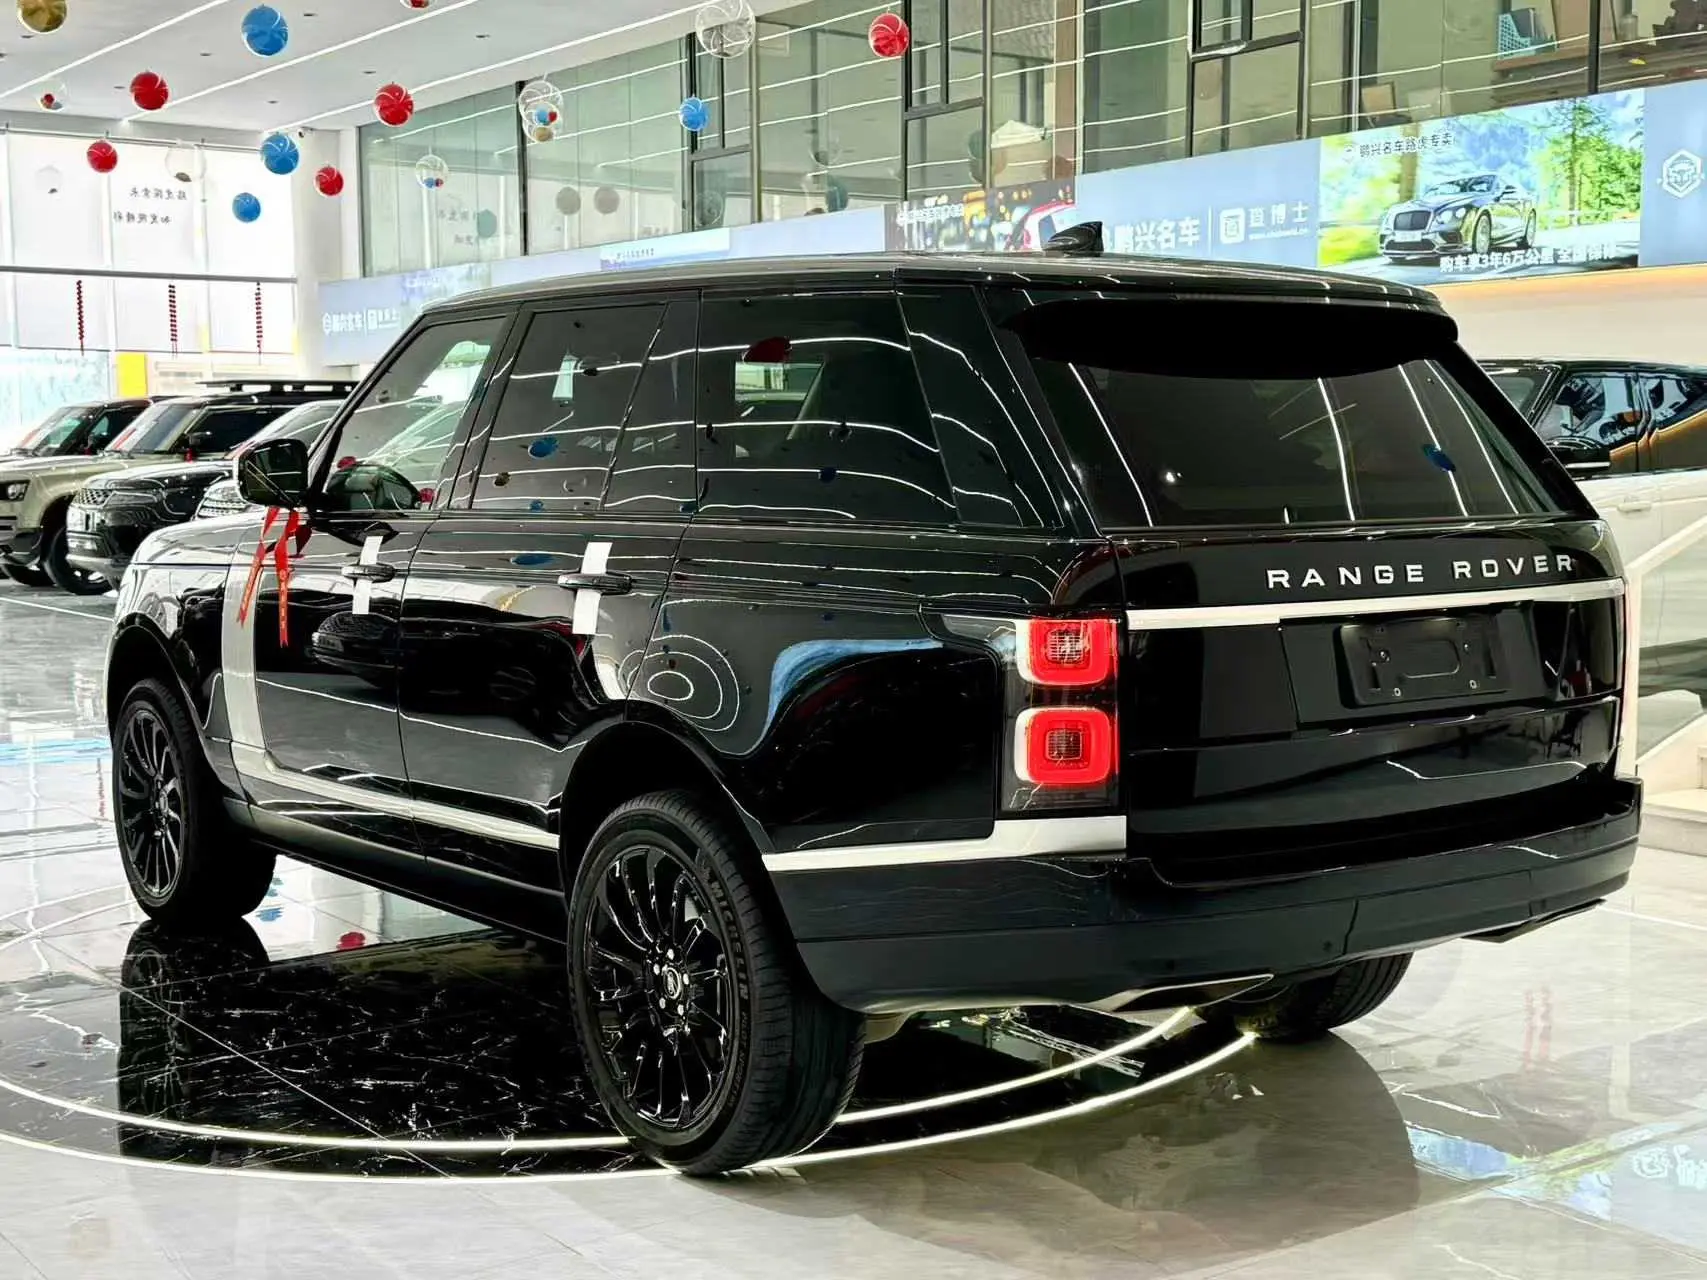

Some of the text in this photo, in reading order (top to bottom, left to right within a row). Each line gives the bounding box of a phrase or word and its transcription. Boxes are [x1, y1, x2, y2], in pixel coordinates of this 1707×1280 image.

[1266, 554, 1574, 589] RANGE ROVER
[711, 880, 749, 1000] MICHELIN
